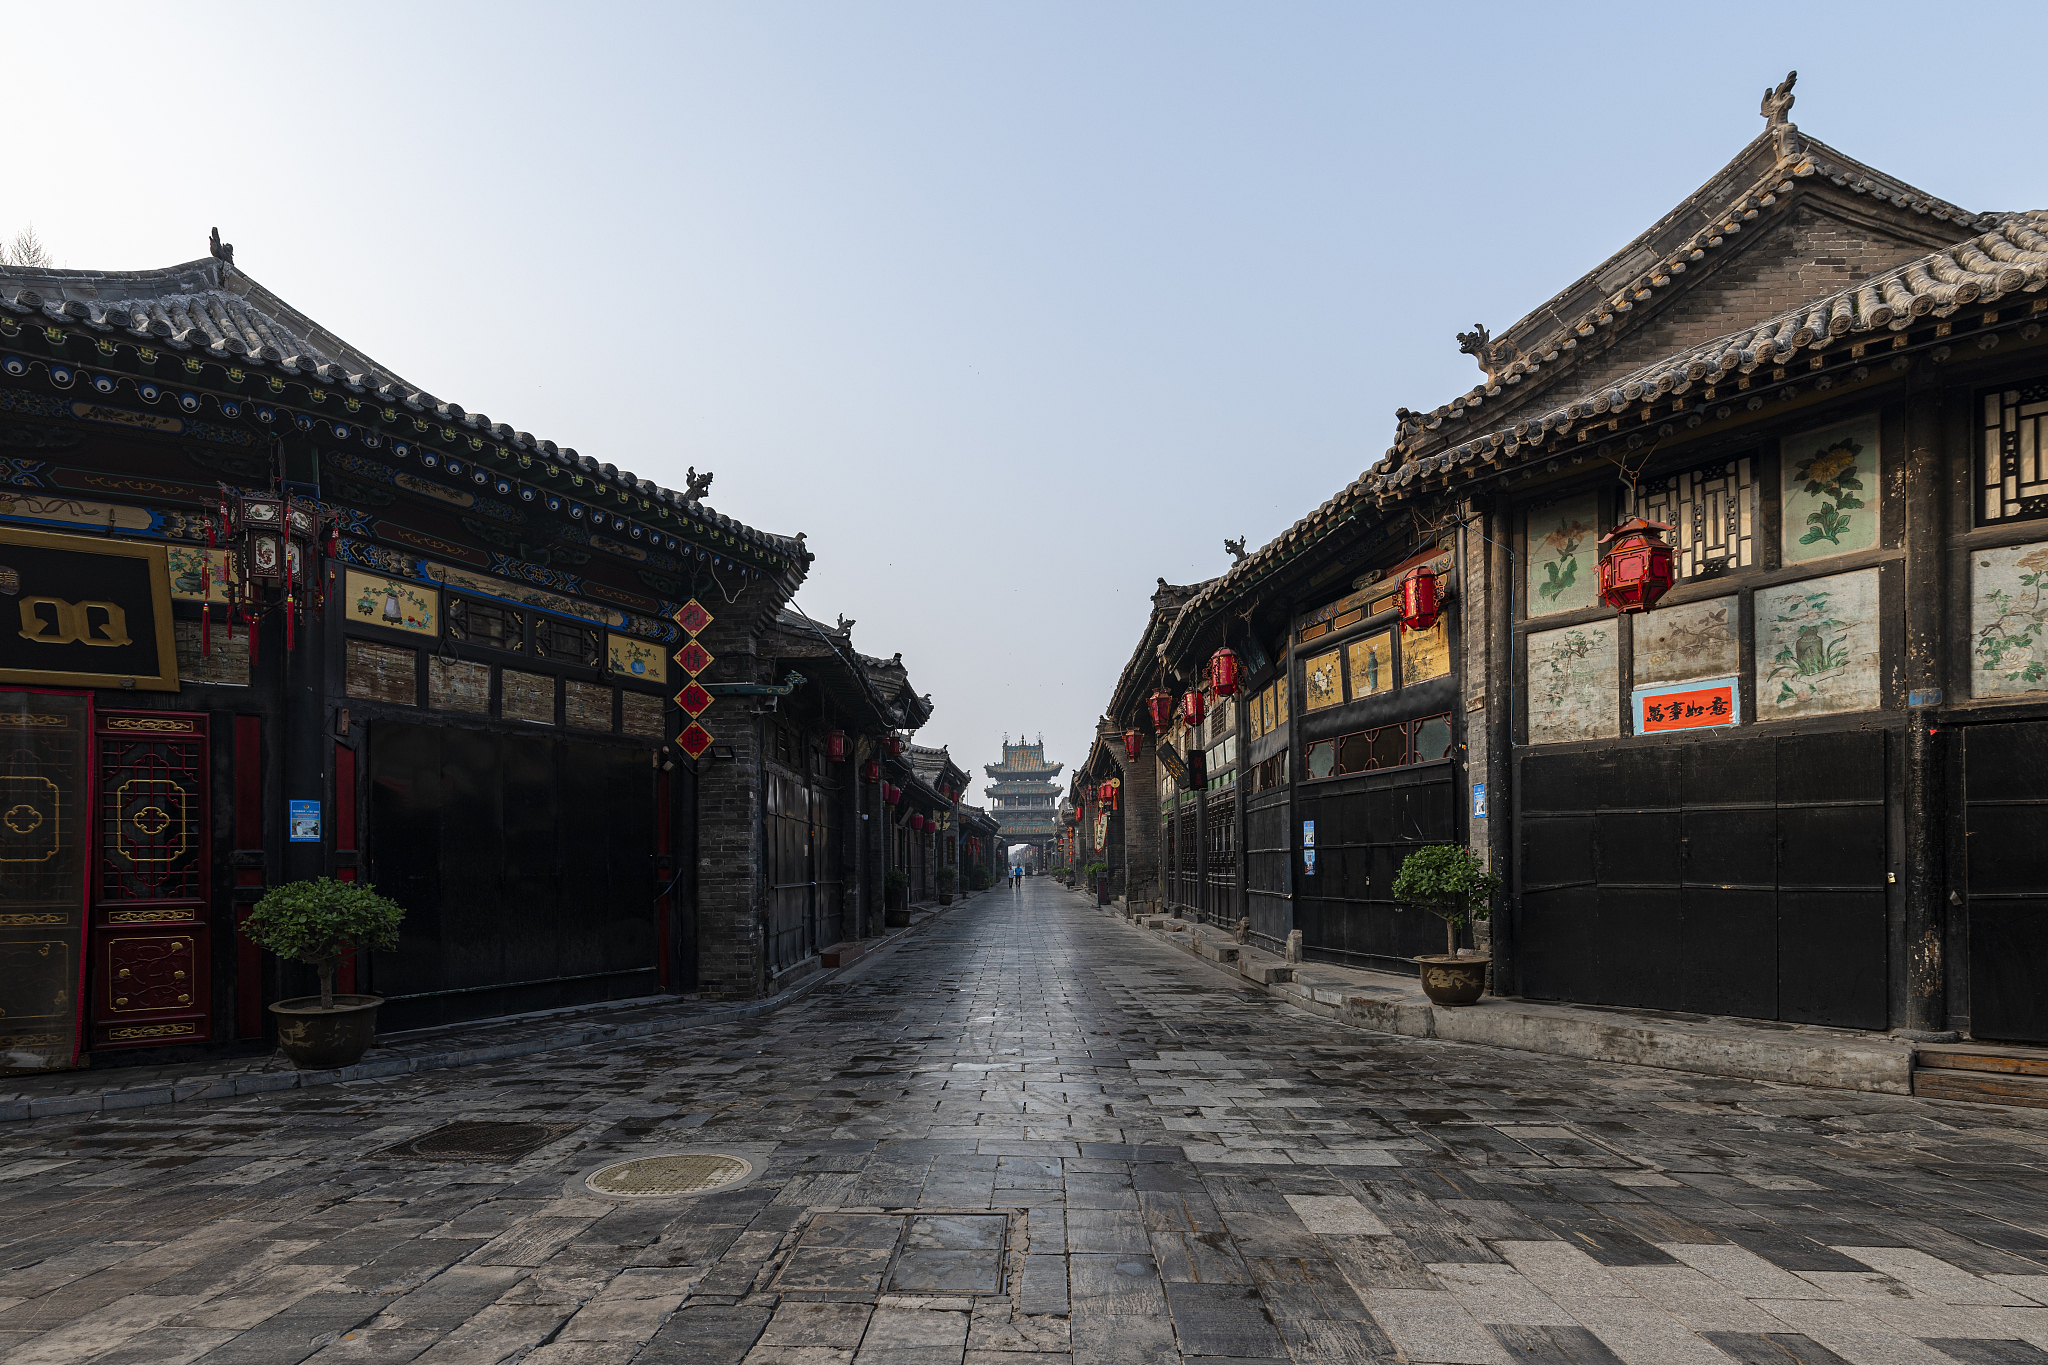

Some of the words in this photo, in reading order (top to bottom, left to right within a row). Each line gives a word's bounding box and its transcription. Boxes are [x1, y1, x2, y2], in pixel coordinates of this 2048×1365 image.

[684, 608, 704, 747] 親情飯莊
[1646, 697, 1729, 722] 萬事如意
